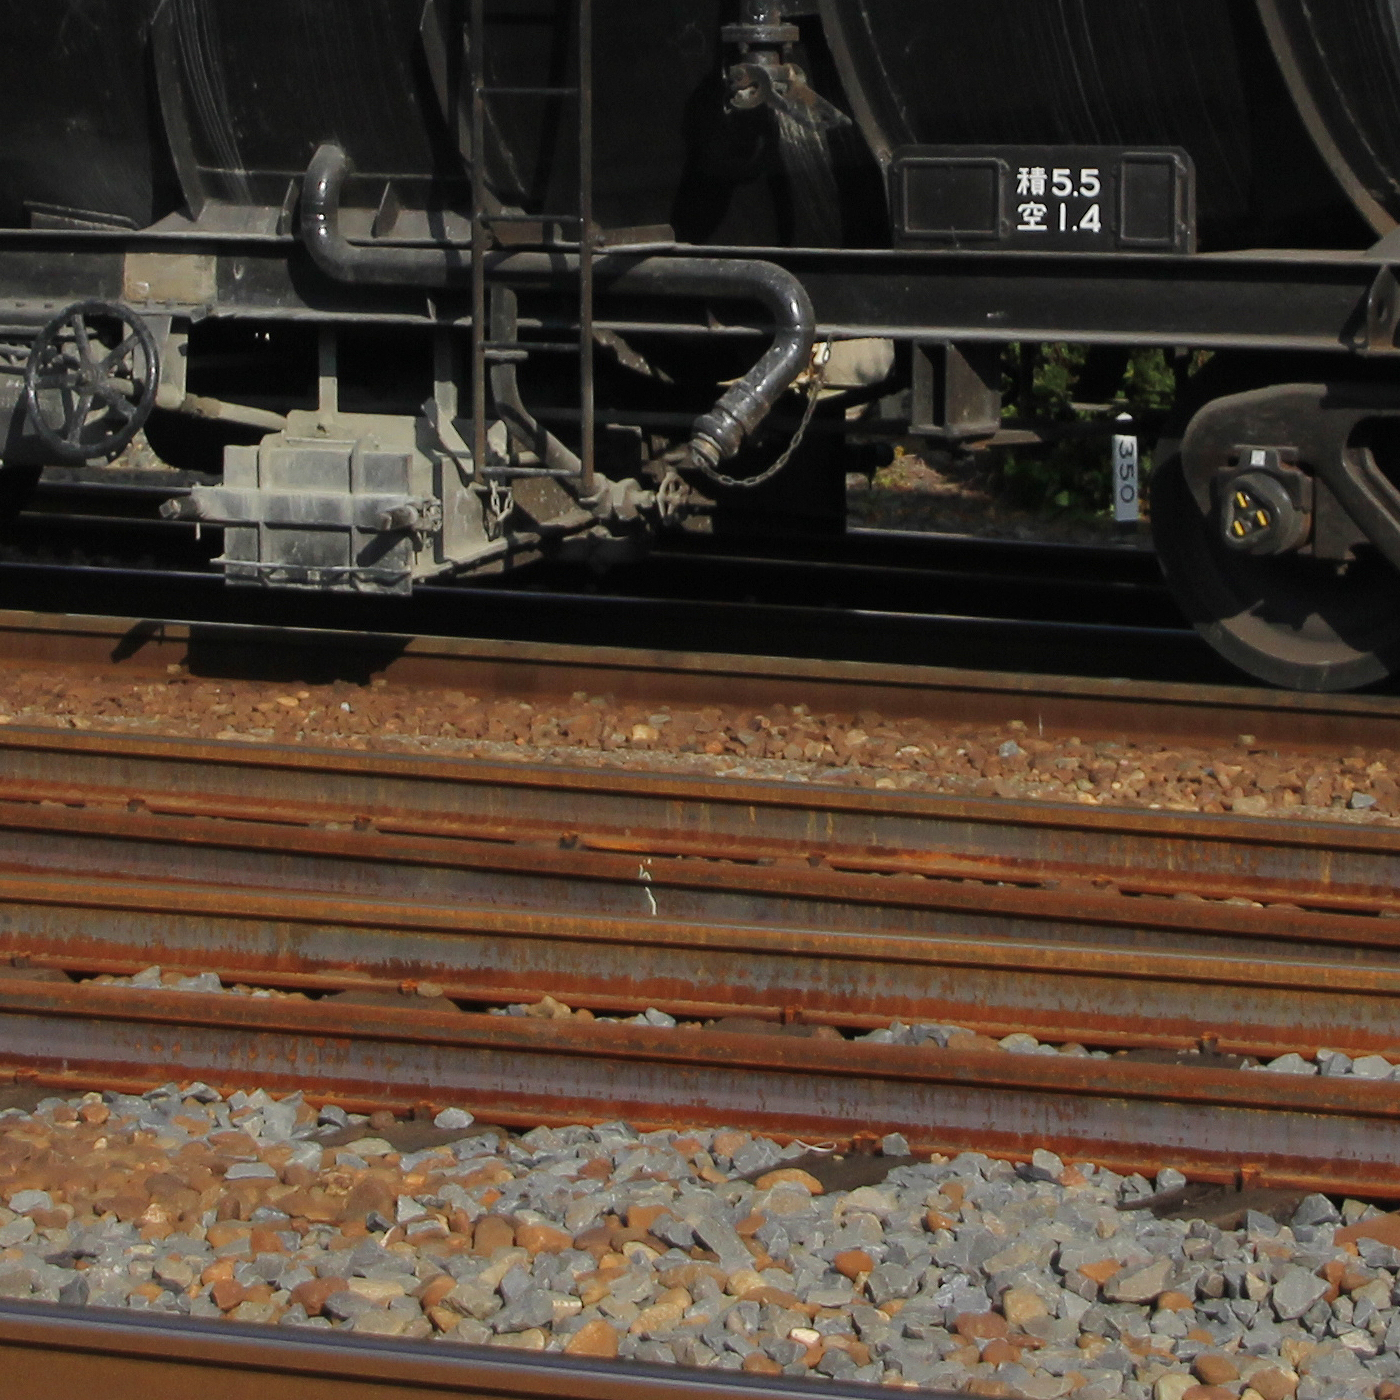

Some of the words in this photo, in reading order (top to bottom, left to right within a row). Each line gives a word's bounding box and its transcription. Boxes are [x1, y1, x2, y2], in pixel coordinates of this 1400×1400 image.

[1051, 168, 1101, 197] 5.5
[1017, 201, 1048, 231] 空
[1059, 202, 1101, 232] 1.4
[1119, 440, 1135, 504] 350
